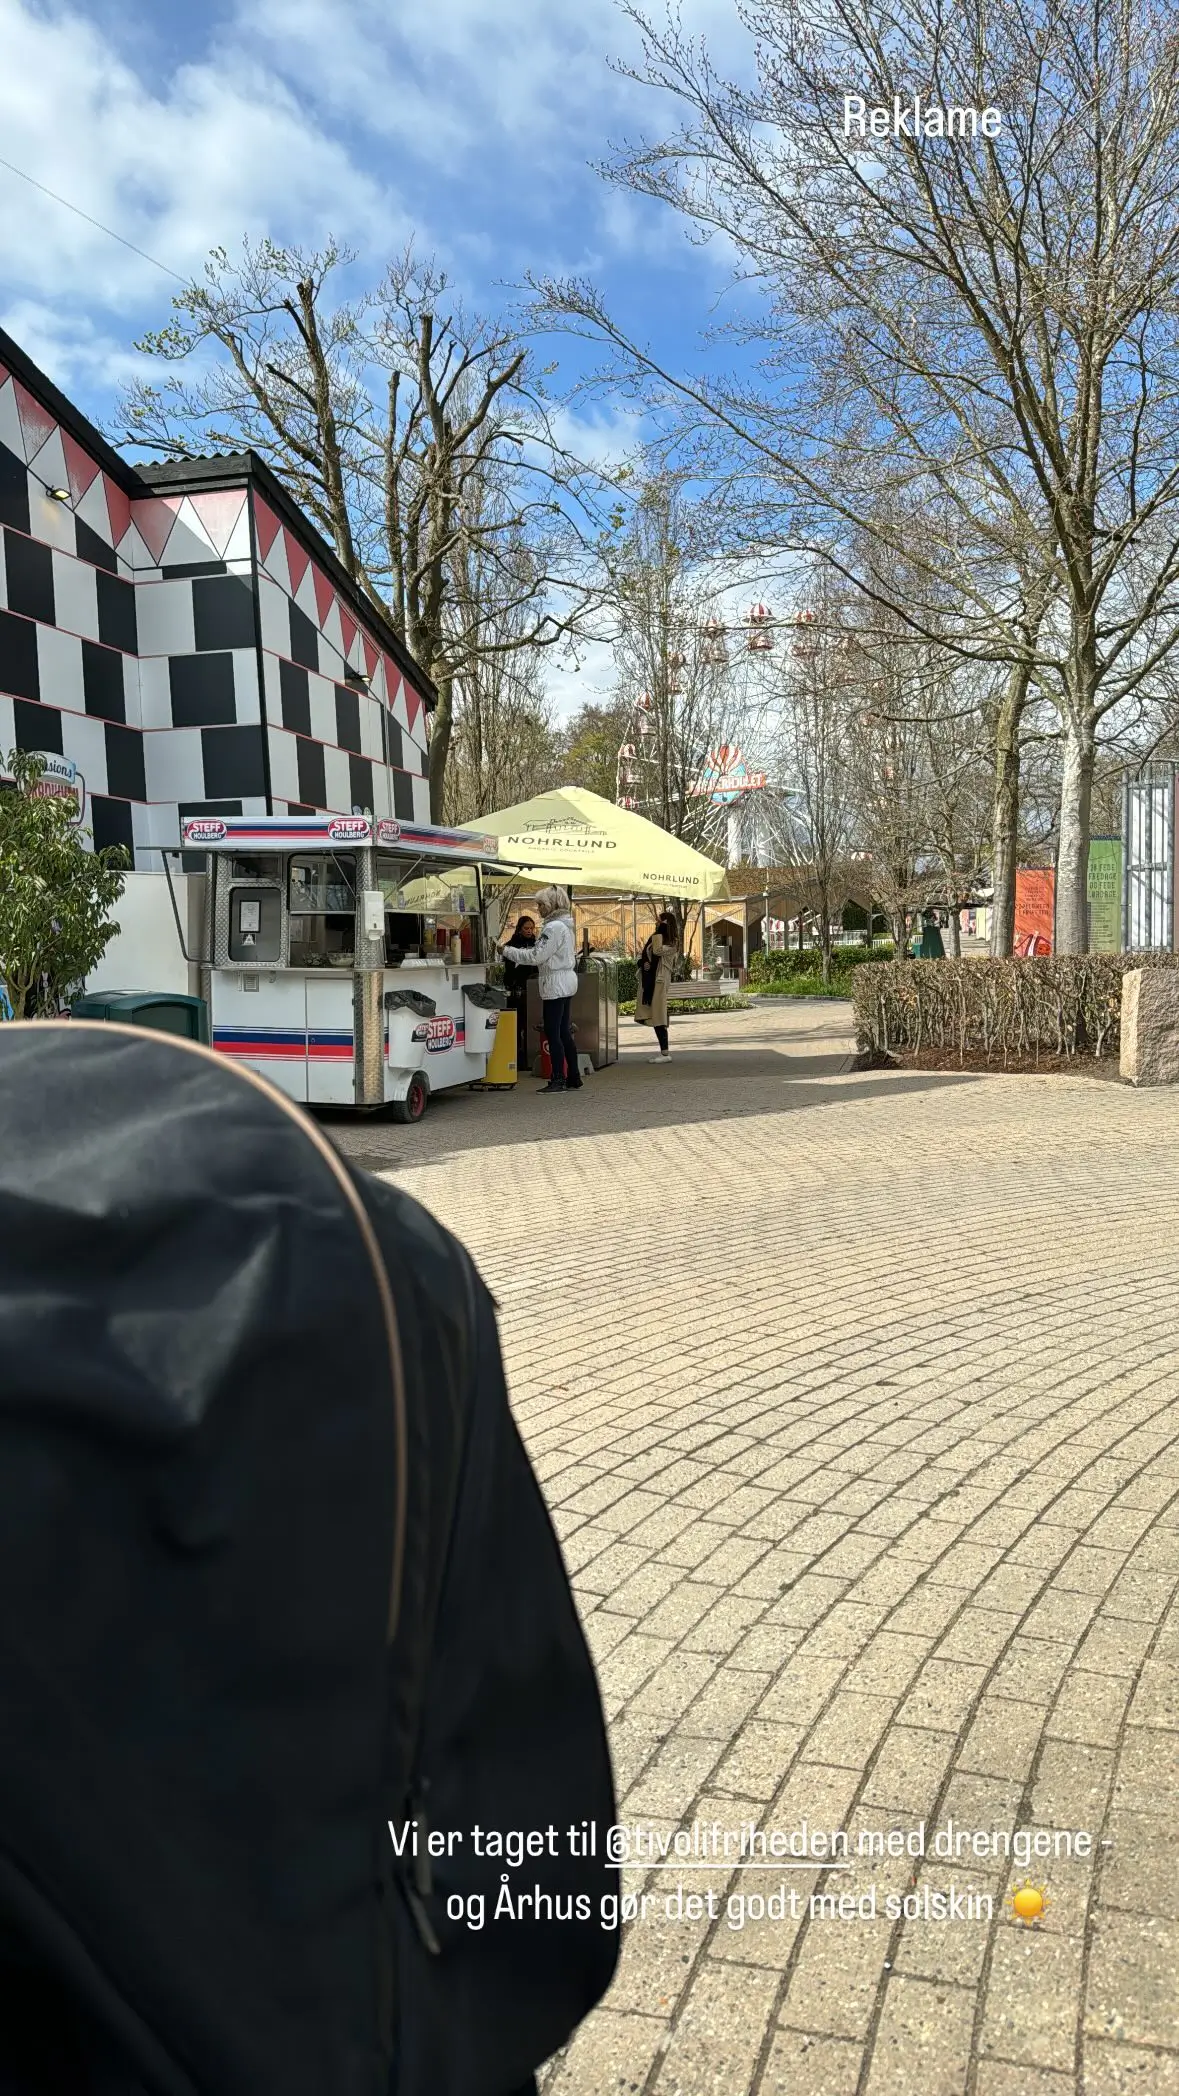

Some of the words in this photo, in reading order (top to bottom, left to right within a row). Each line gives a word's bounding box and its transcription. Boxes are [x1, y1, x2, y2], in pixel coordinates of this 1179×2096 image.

[192, 822, 221, 832] STEFF
[334, 821, 364, 831] STEFF
[382, 822, 398, 833] STEFF
[193, 832, 222, 840] HOULBERG
[334, 831, 365, 839] HOULBERG
[507, 836, 617, 849] NOHRLUND
[642, 872, 699, 885] NOHRLUND
[427, 1020, 451, 1039] STEFF
